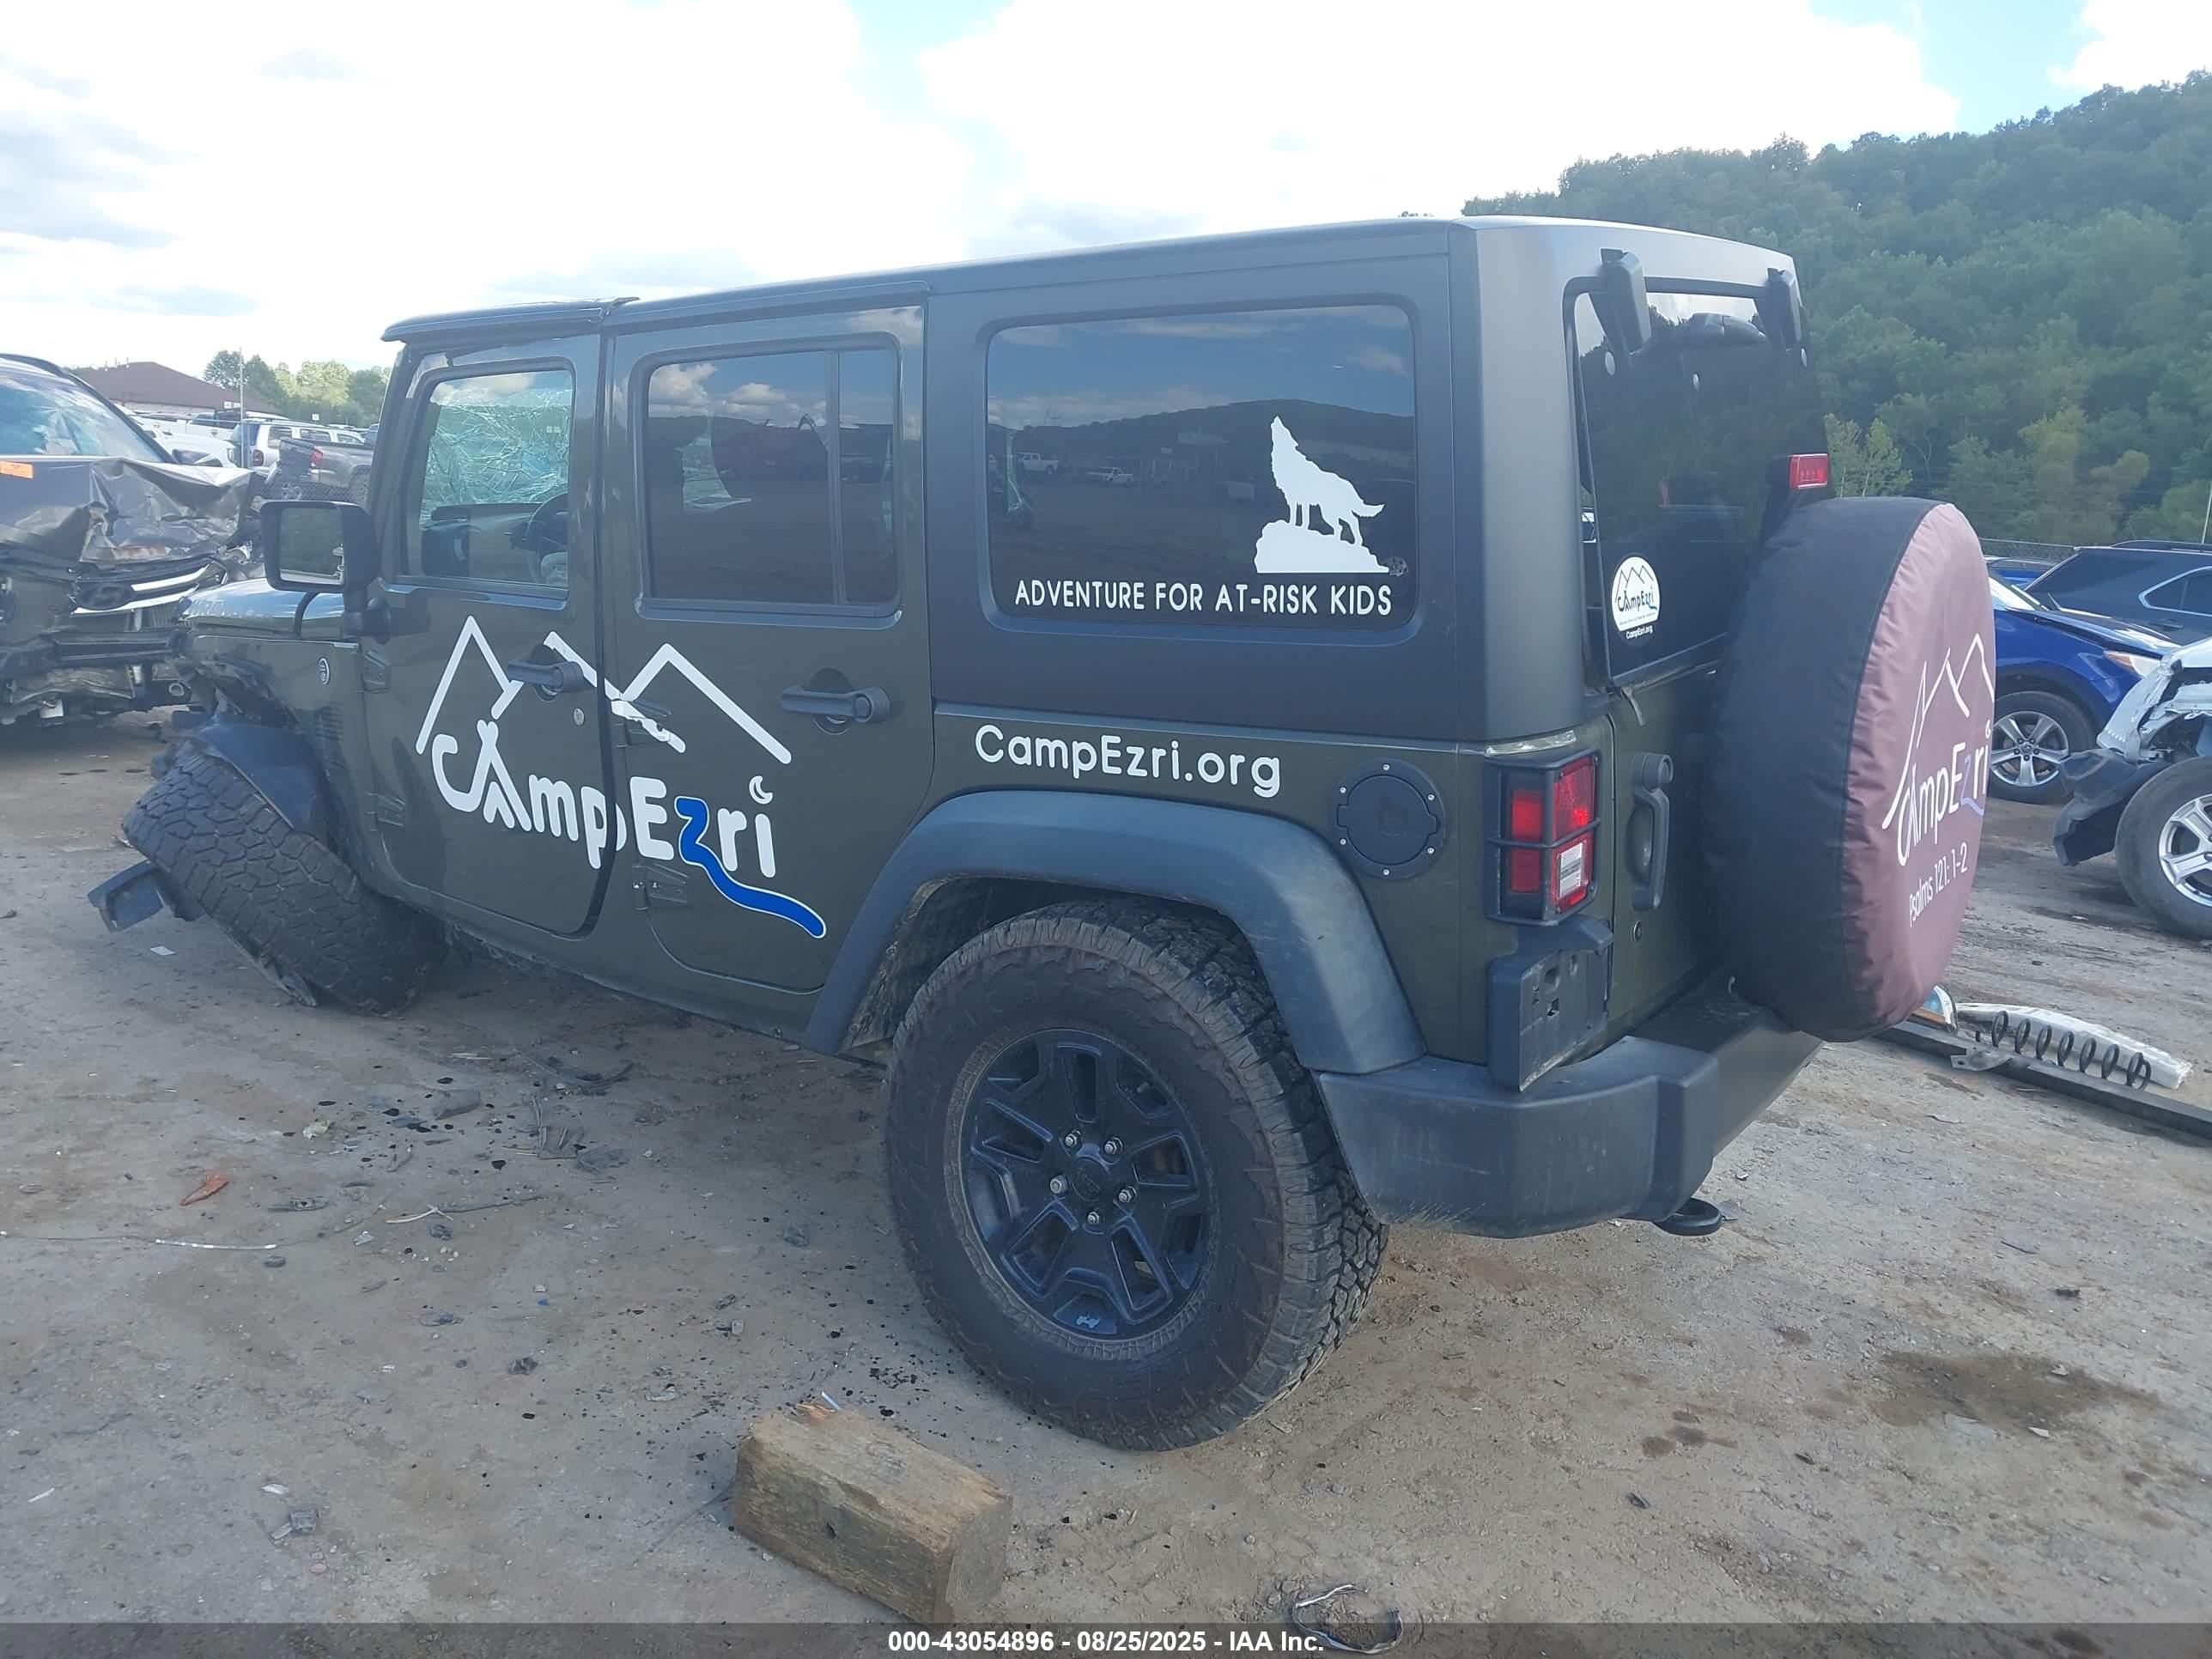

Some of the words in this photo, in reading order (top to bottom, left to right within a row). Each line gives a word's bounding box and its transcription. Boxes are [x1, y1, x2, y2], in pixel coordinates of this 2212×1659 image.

[1016, 580, 1144, 609] ADVENTURE
[1157, 583, 1202, 611] FOR
[1216, 585, 1316, 613] AT-RISK
[1331, 586, 1390, 615] KIDS
[975, 725, 1280, 798] CampEzri.org
[1910, 876, 1933, 927] Psalms
